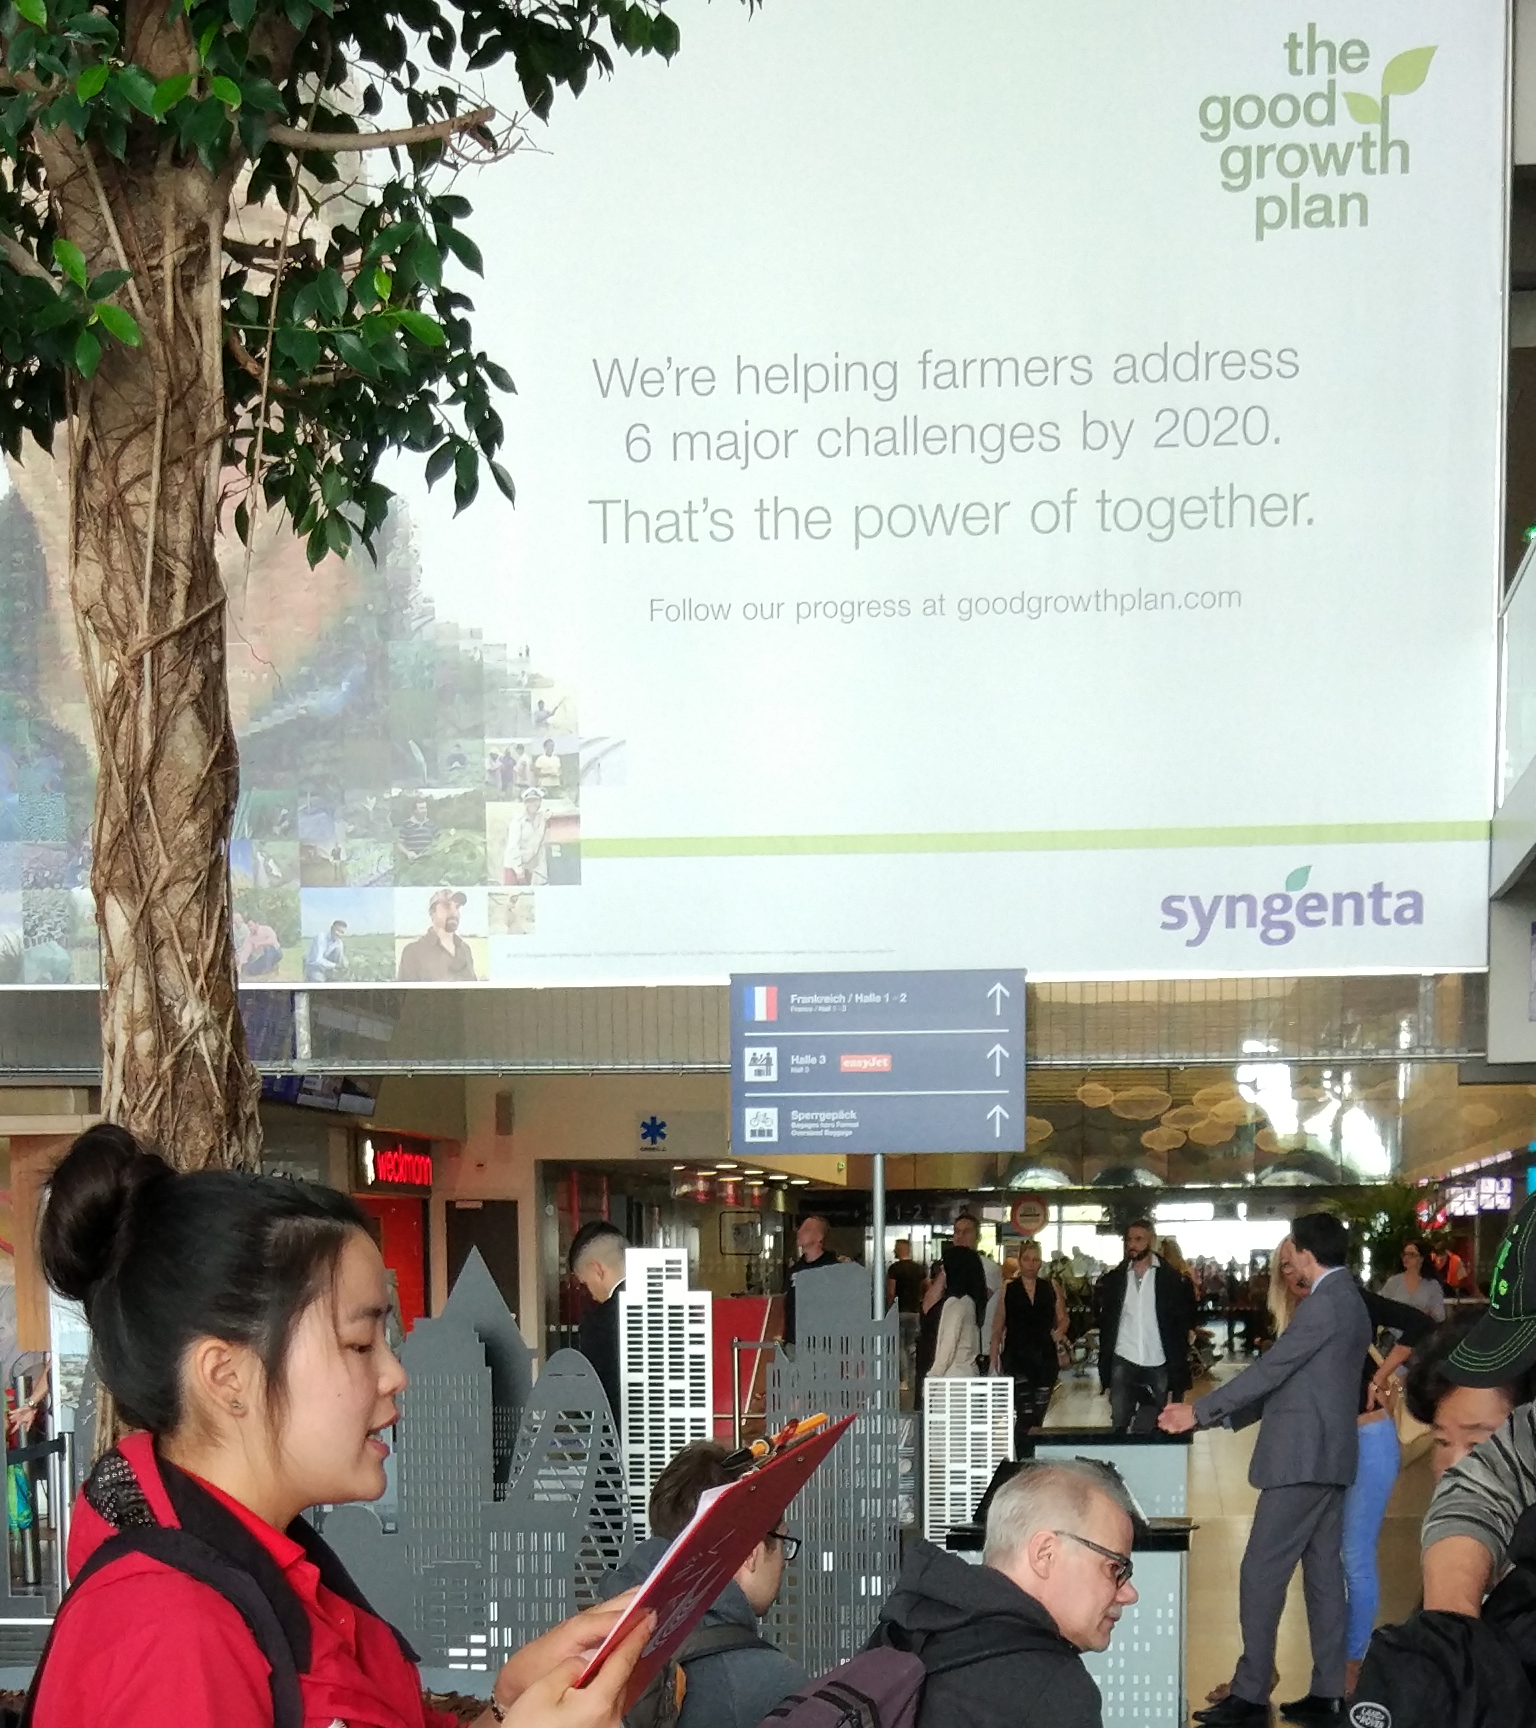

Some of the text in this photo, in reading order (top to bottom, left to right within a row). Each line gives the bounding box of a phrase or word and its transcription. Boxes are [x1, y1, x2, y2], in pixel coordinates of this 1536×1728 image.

[1283, 22, 1370, 76] the
[1198, 79, 1336, 143] good
[1219, 95, 1410, 193] growth
[1255, 182, 1368, 242] plan
[736, 351, 898, 404] helping
[918, 348, 1094, 391] farmers
[1112, 340, 1301, 385] address
[625, 405, 1281, 471] 6 major challenges by 2020.
[753, 495, 832, 541] the
[854, 500, 1011, 550] power
[1030, 488, 1078, 535] of
[1096, 482, 1315, 543] together.
[650, 586, 1243, 625] Follow our progress at goodgrowthplan.com
[1159, 880, 1425, 948] syngenta
[790, 992, 846, 1005] Frankreich
[790, 1055, 817, 1066] Halle
